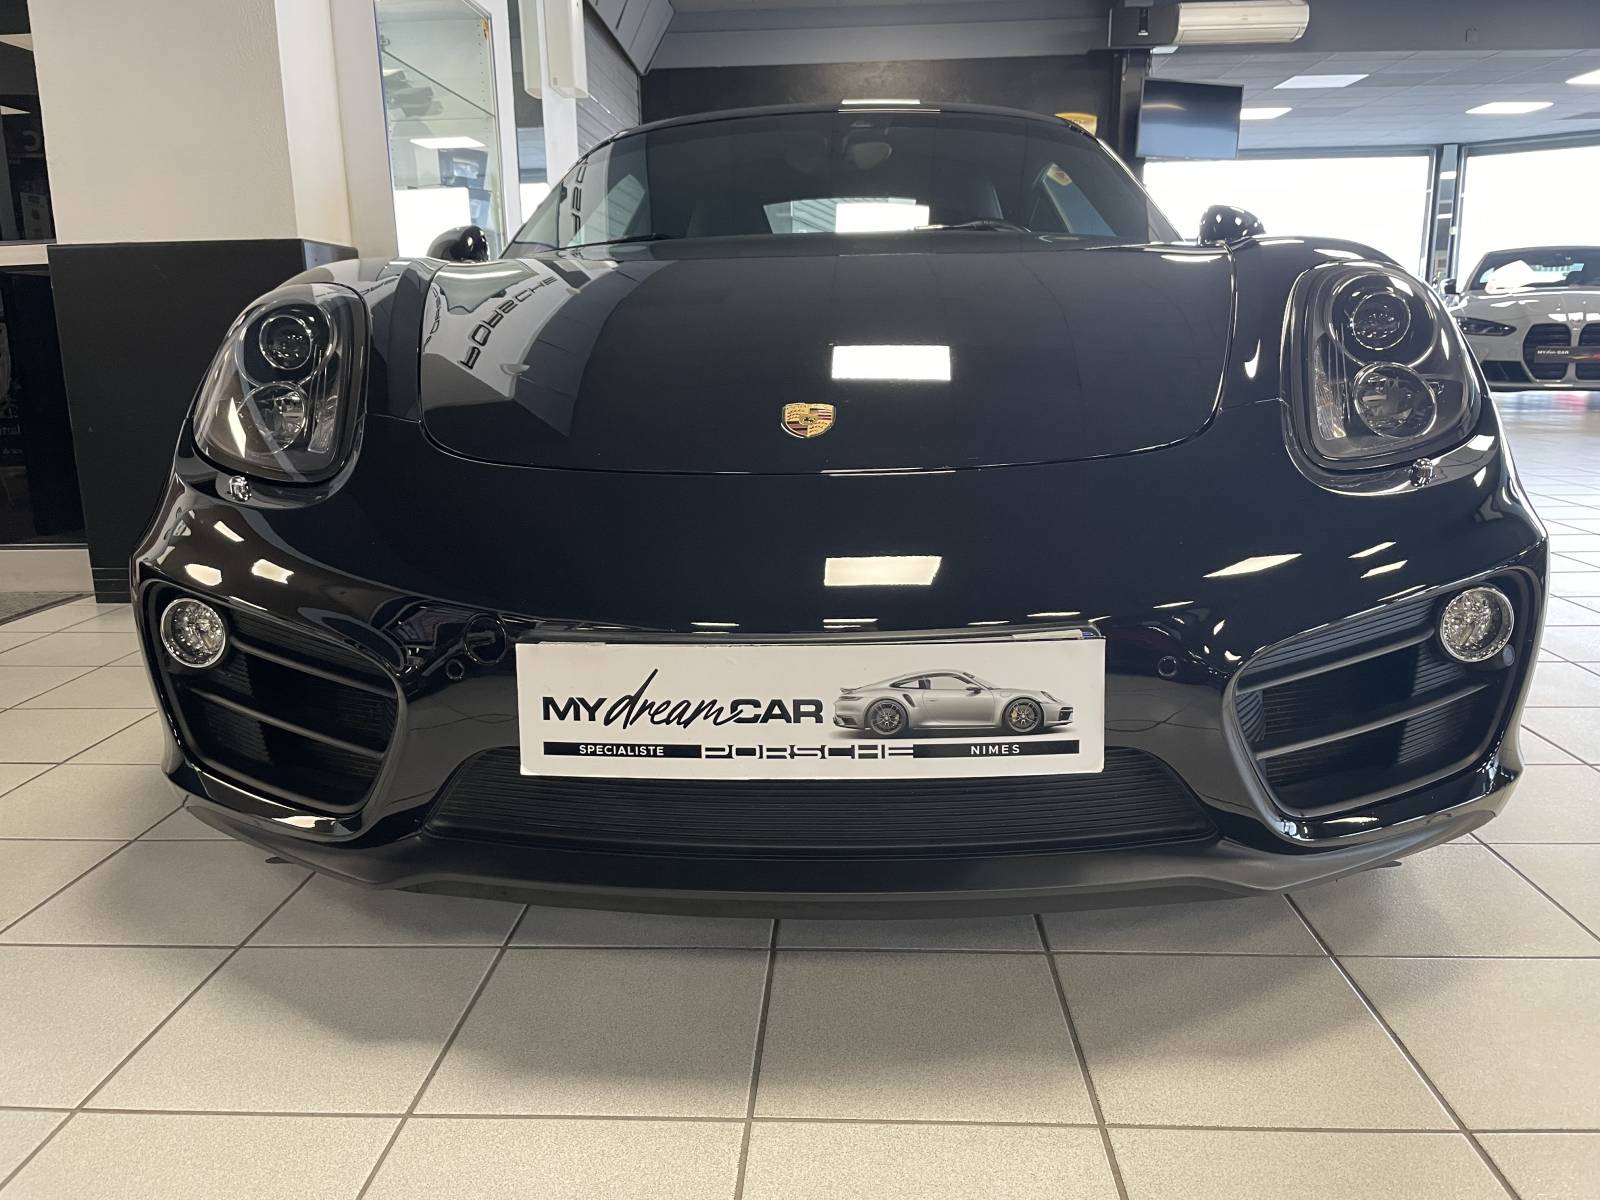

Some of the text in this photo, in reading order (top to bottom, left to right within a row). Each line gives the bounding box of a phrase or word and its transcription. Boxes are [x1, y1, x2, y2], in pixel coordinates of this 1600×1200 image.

[543, 668, 823, 729] MY dream CAR
[579, 744, 1020, 759] SPECIALISTE PORSCHE NIMES
